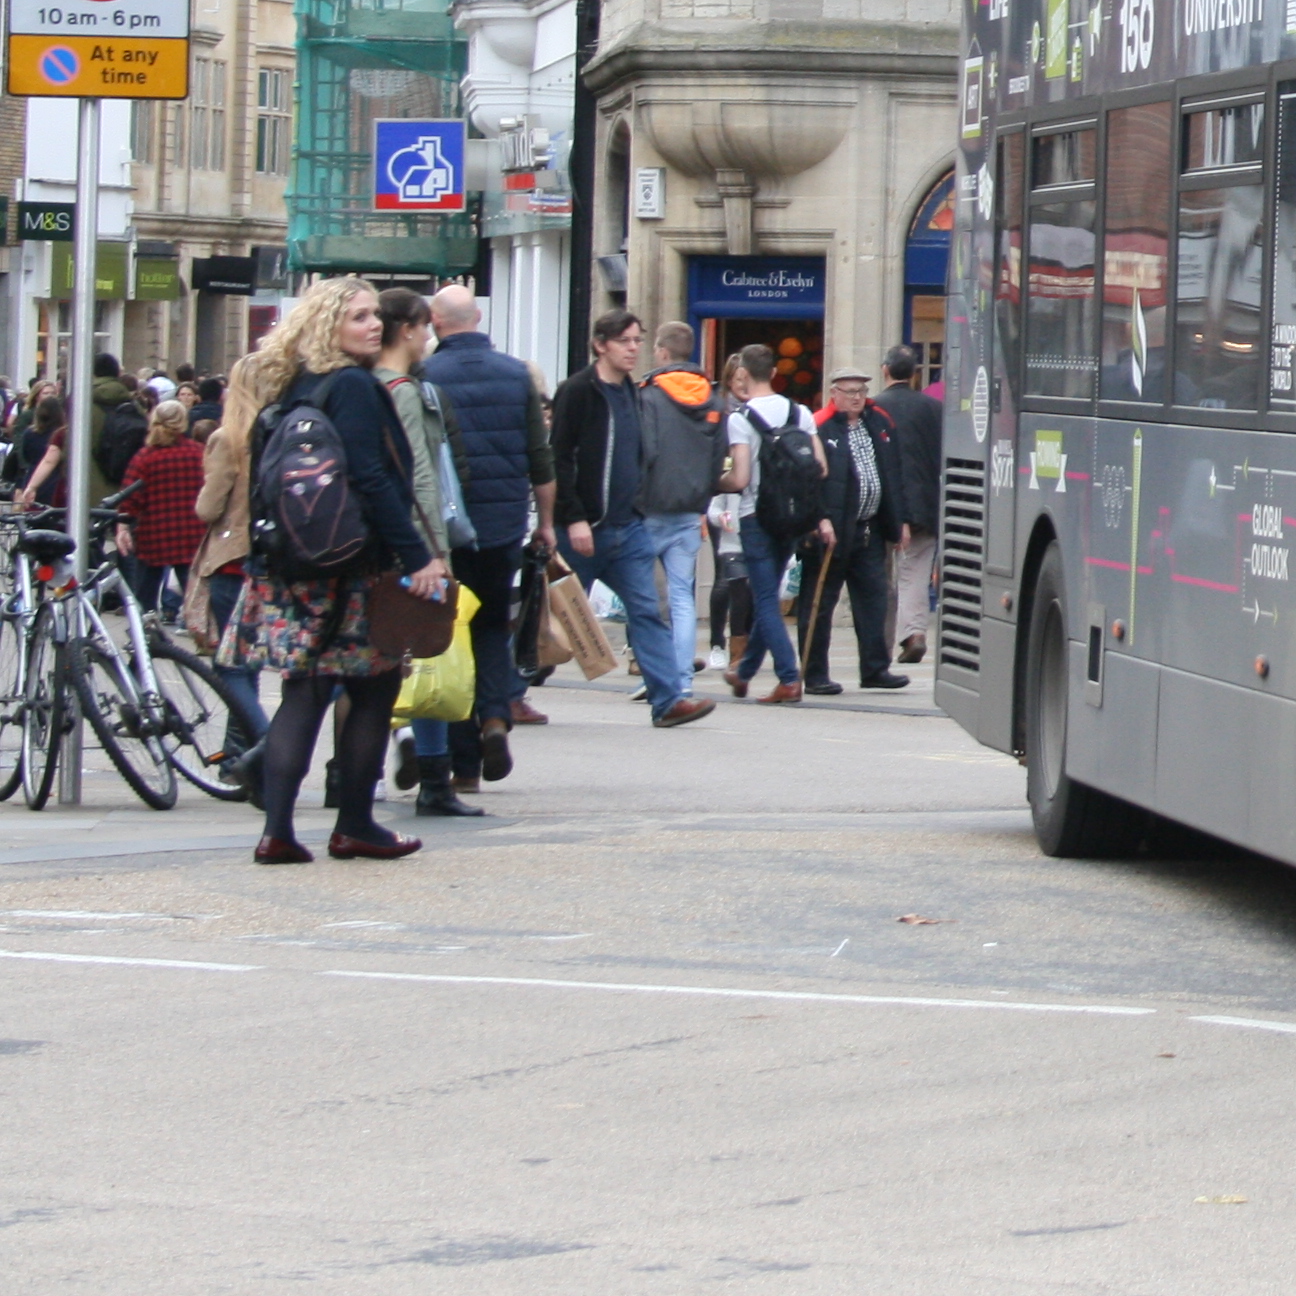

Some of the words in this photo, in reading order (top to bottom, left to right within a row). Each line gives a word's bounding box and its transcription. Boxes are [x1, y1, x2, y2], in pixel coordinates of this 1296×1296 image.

[38, 8, 63, 25] 10
[67, 13, 97, 26] am
[113, 10, 126, 27] 6
[130, 14, 161, 29] pm
[90, 45, 114, 62] At
[123, 49, 160, 66] any
[101, 70, 147, 85] time
[24, 212, 70, 231] M&S
[722, 269, 767, 287] Crabtree
[769, 271, 778, 286] &
[778, 269, 815, 292] Evelyn
[748, 290, 788, 298] LONDON
[1252, 504, 1283, 539] GLOBAL
[1251, 543, 1289, 580] OUTLOOK
